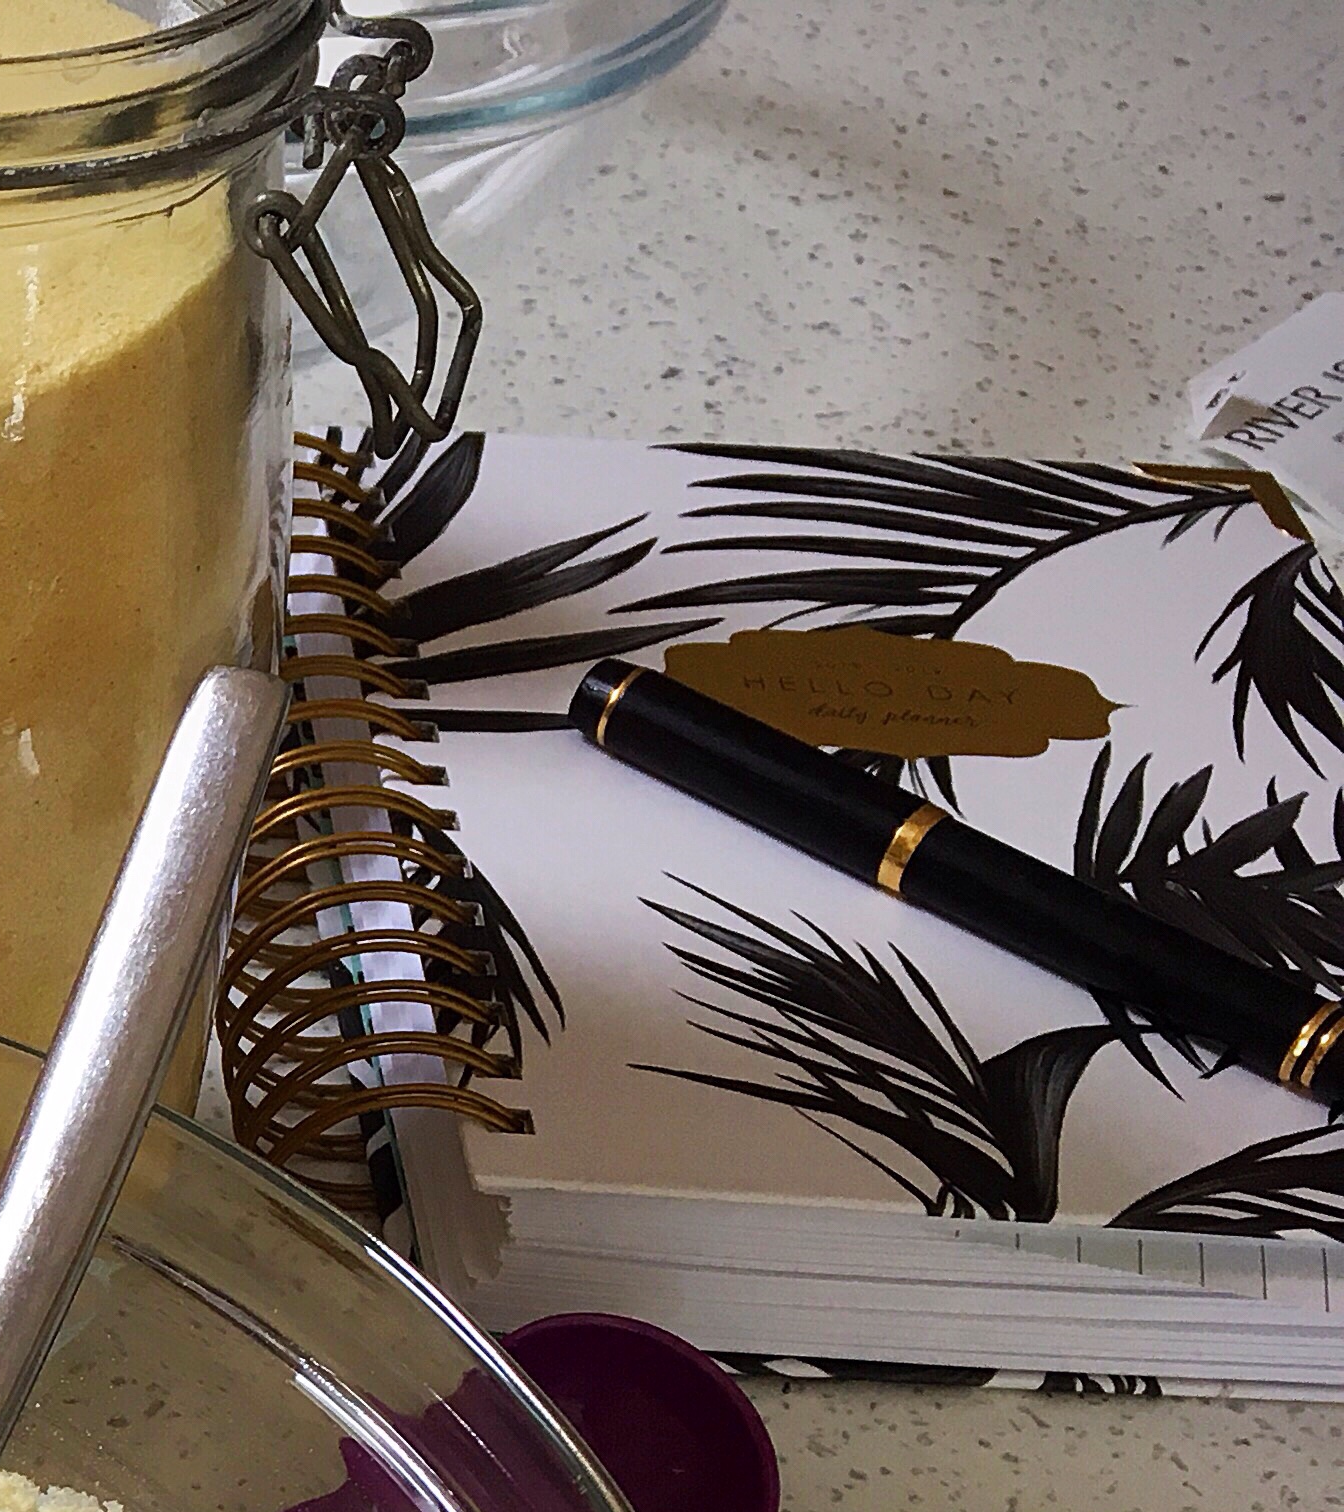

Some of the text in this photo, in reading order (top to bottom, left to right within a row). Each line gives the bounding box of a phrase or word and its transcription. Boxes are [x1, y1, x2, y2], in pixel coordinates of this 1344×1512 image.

[1224, 384, 1343, 451] RIVER
[743, 675, 1020, 705] HELLO DAY
